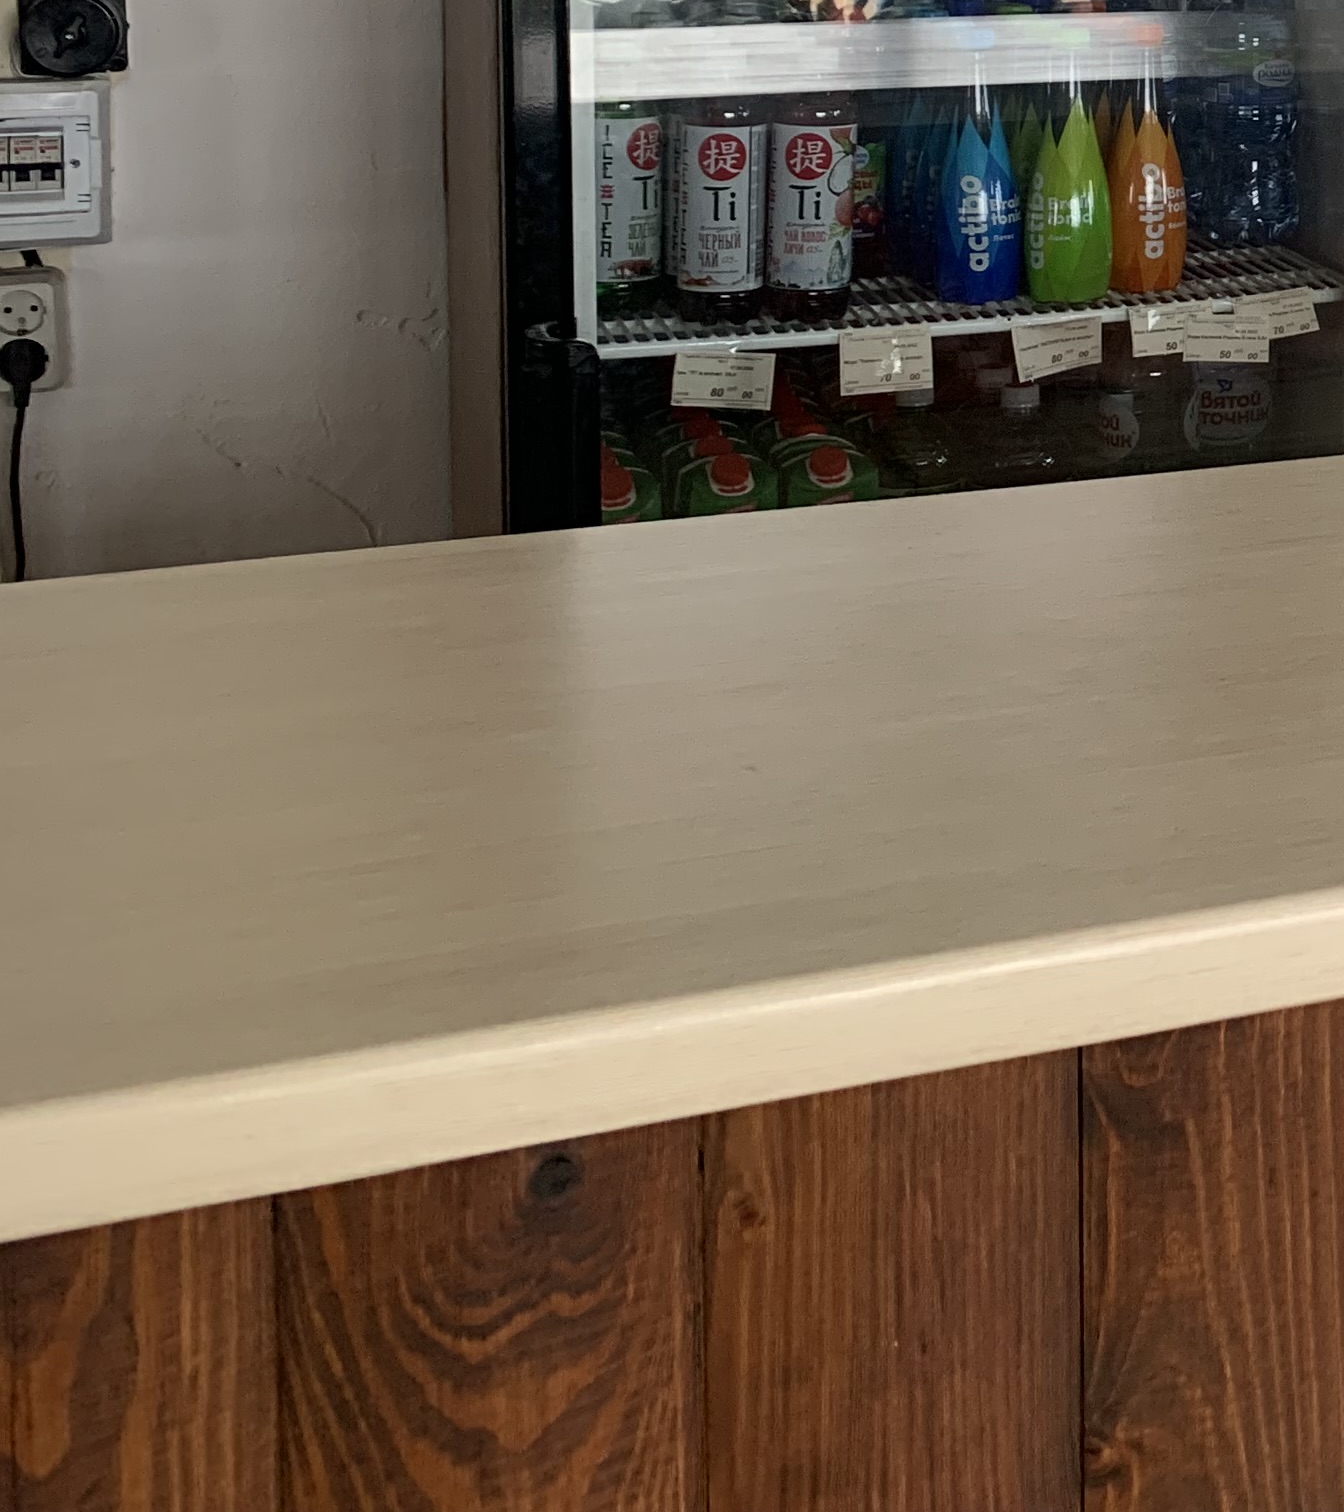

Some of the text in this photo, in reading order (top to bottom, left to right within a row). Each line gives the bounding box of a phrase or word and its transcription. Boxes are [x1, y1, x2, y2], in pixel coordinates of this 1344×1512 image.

[702, 138, 742, 175] 提
[788, 138, 829, 175] 提
[632, 175, 659, 210] Ti
[703, 185, 737, 221] Ti
[788, 184, 822, 220] Ti
[958, 174, 990, 272] actibo
[1028, 171, 1045, 270] actibo
[1138, 162, 1165, 260] actibo
[699, 230, 742, 251] ЧЕРНЫЙ
[699, 251, 719, 268] ЧАЙ
